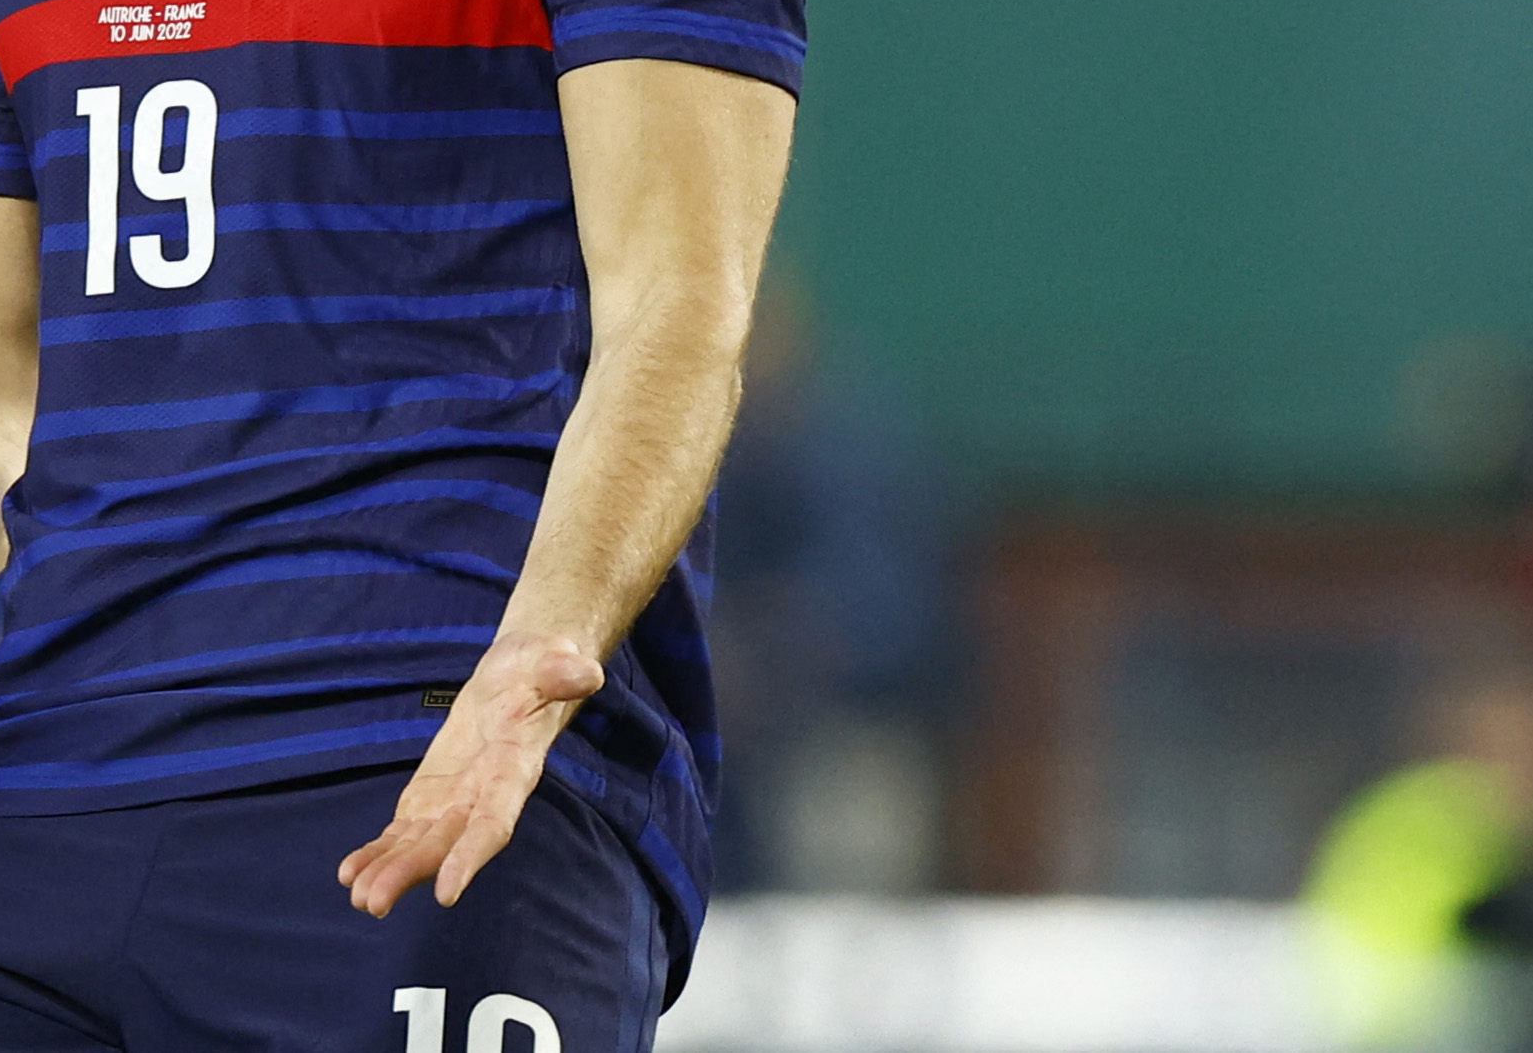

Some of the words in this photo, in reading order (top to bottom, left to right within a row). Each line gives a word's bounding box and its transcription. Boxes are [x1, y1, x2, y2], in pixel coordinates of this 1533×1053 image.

[98, 6, 153, 24] AUTRICHE
[164, 2, 206, 21] FRANCE
[110, 25, 127, 42] 10
[128, 24, 155, 42] JUIN
[156, 22, 192, 40] 2022
[76, 79, 218, 296] 19
